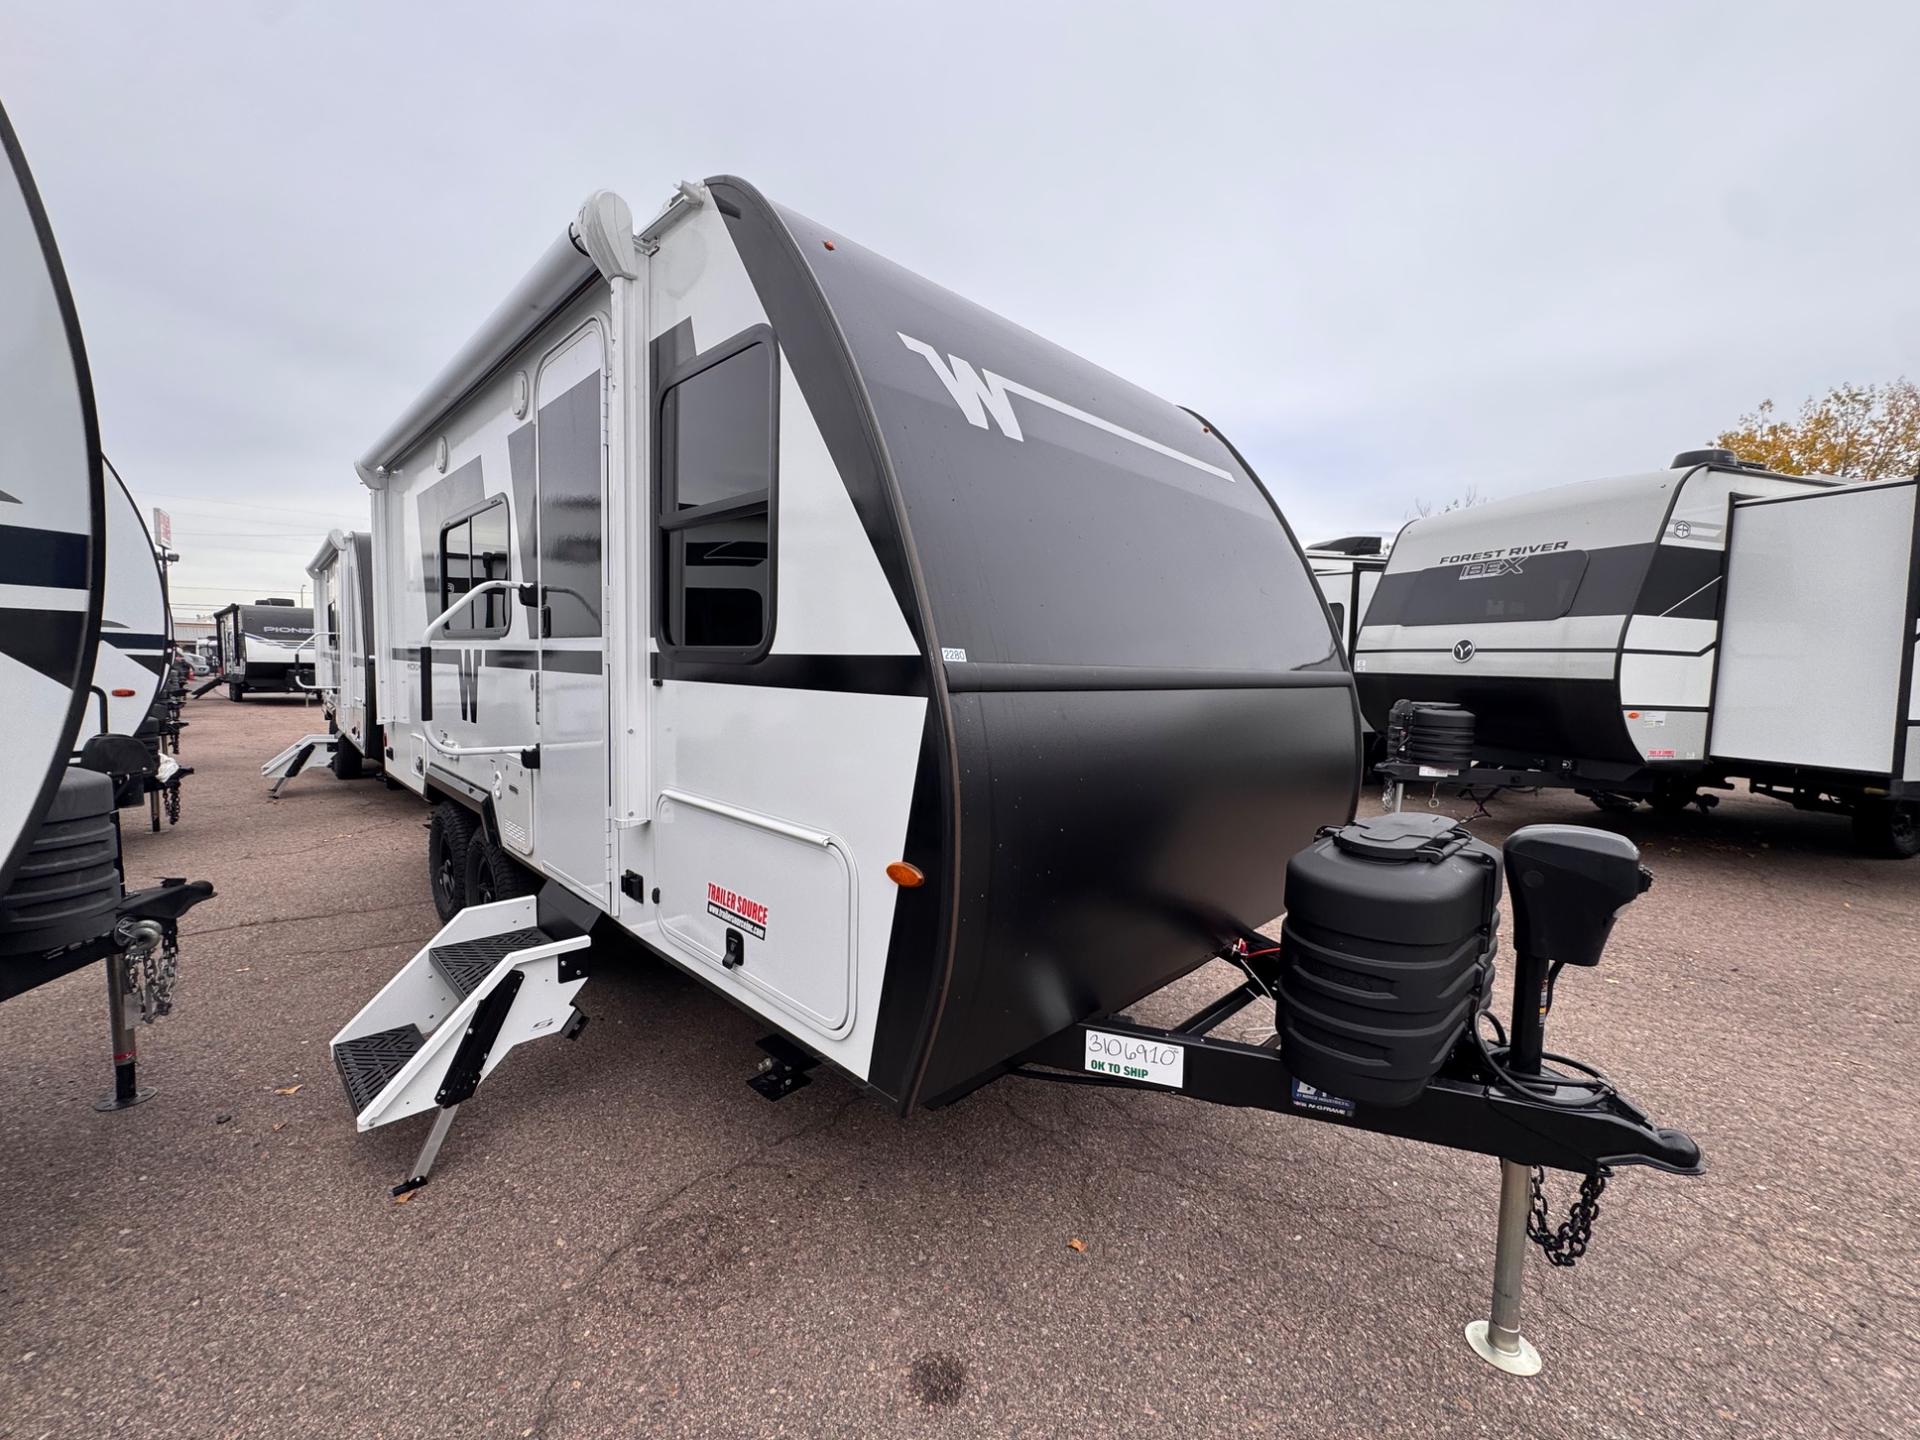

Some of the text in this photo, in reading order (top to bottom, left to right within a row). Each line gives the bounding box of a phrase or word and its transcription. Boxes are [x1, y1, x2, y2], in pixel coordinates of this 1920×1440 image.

[1439, 540, 1569, 565] FOREST RIVER
[1459, 556, 1529, 580] IBEX
[943, 649, 966, 661] 2280
[707, 882, 769, 926] TRAILER SOURCE
[1091, 1059, 1149, 1079] OK TO SHIP
